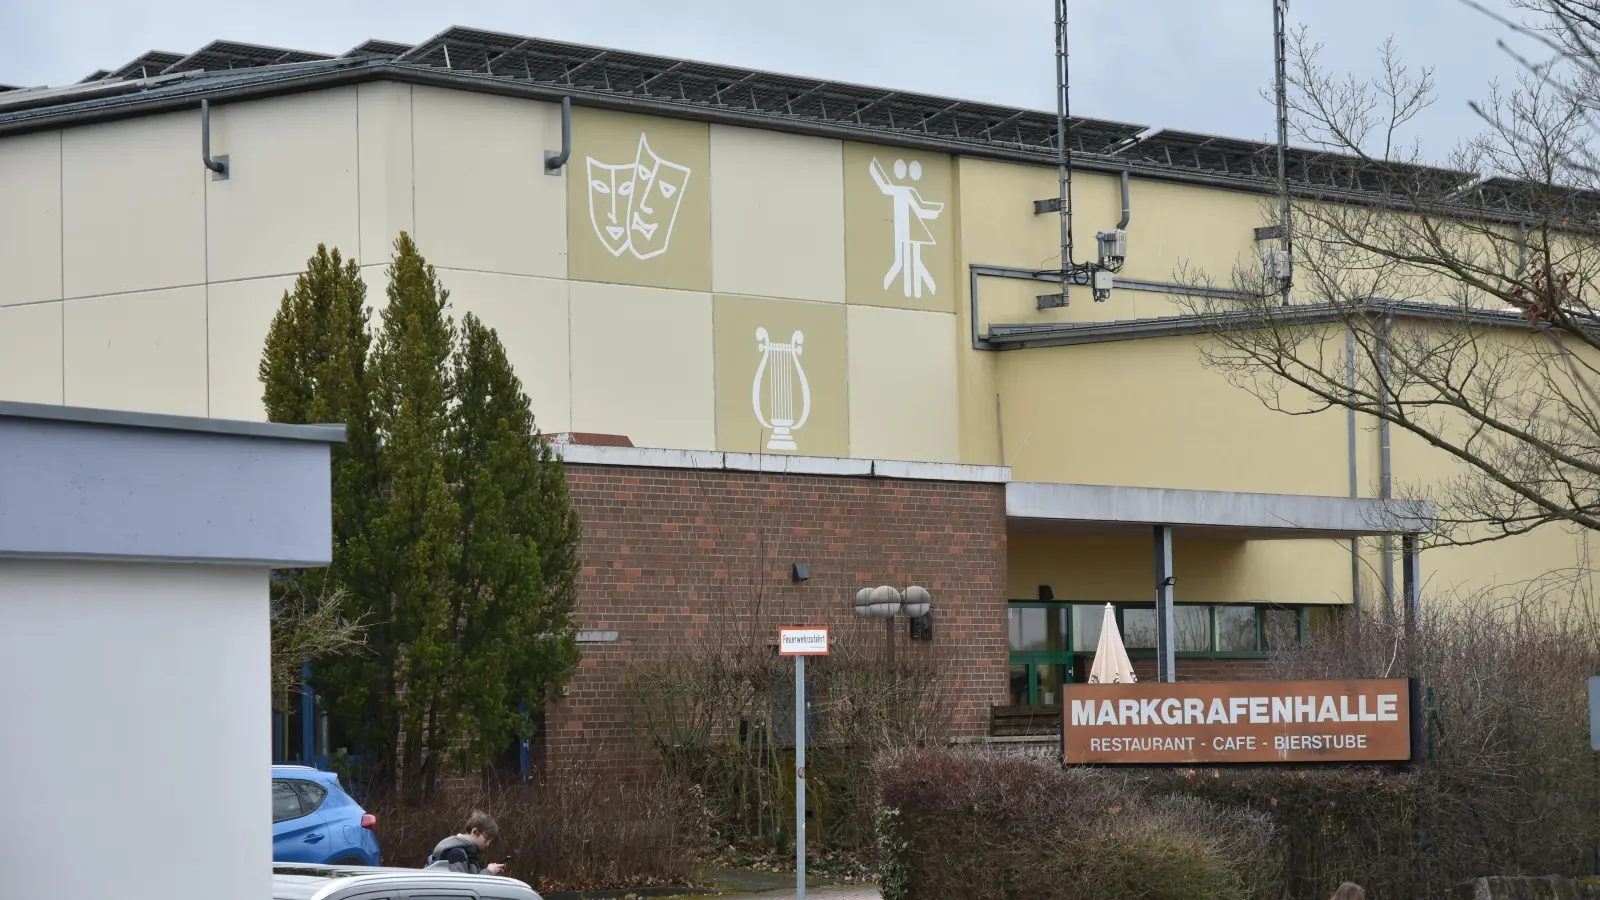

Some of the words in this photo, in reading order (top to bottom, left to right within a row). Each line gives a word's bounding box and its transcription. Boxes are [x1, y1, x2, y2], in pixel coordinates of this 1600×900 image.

[782, 634, 825, 644] Feuerwehrzufahrt
[1071, 694, 1398, 726] MARKGRAFENHALLE
[1090, 737, 1195, 752] RESTAURANT
[1212, 736, 1257, 750] CAFE
[1274, 734, 1367, 750] BIERSTUBE
